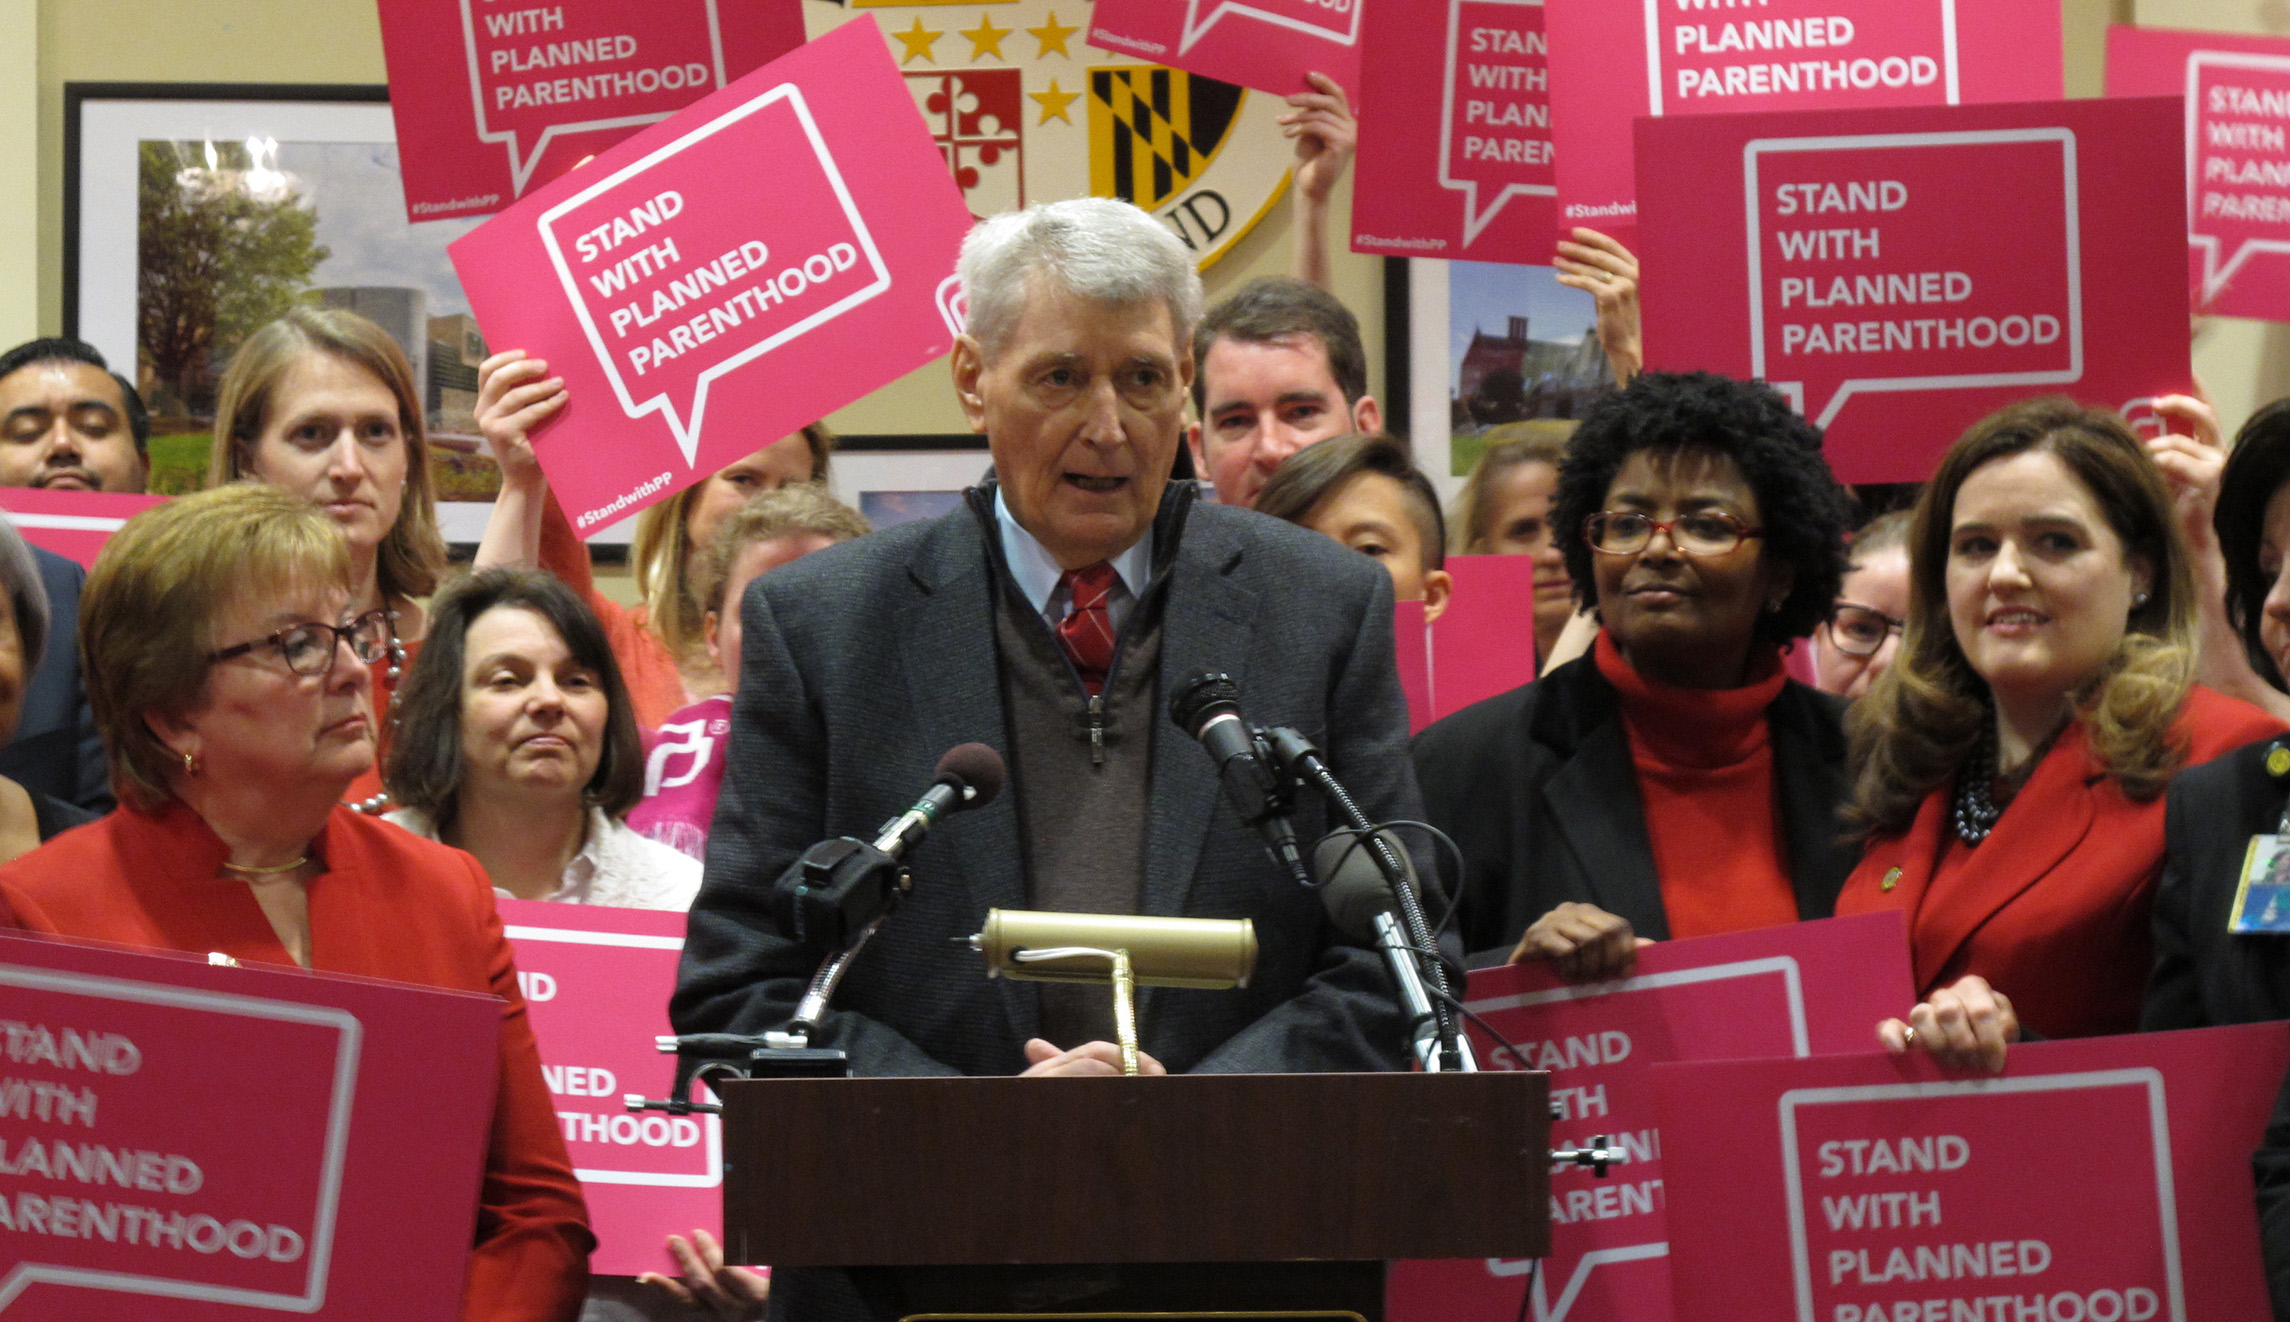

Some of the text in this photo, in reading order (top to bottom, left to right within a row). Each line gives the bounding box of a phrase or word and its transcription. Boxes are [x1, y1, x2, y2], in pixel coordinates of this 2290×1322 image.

[485, 6, 564, 38] WITH
[1470, 27, 1548, 55] STAN
[1675, 16, 1855, 54] PLANNED
[491, 35, 637, 74] PLANNED
[496, 63, 708, 110] PARENTHOOD
[1468, 64, 1548, 91] WITH
[1677, 56, 1938, 98] PARENTHOOD
[1466, 100, 1553, 128] PLAN
[2208, 85, 2290, 119] STAN
[2206, 120, 2285, 153] WITH
[2205, 156, 2290, 187] PLAN
[1565, 200, 1637, 218] #Standwi
[1776, 180, 1908, 214] STAND
[575, 190, 684, 263] STAND
[1776, 227, 1880, 260] WITH
[590, 237, 681, 298] WITH
[610, 240, 769, 338] PLANNED
[1780, 271, 1972, 308] PLANNED
[628, 242, 857, 376] PARENTHOOD
[1783, 314, 2060, 354] PARENTHOOD
[576, 471, 672, 529] #StandwithPP
[0, 1019, 142, 1076] TAND
[1489, 1030, 1632, 1071] STAND
[1549, 1083, 1609, 1121] TH
[556, 1111, 700, 1148] THOOD
[0, 1136, 204, 1195] LANNED
[1818, 1134, 1970, 1178] STAND
[1822, 1190, 1942, 1231] WITH
[1830, 1239, 2052, 1286] PLANNED
[1834, 1287, 2160, 1322] PARENTHOOD
